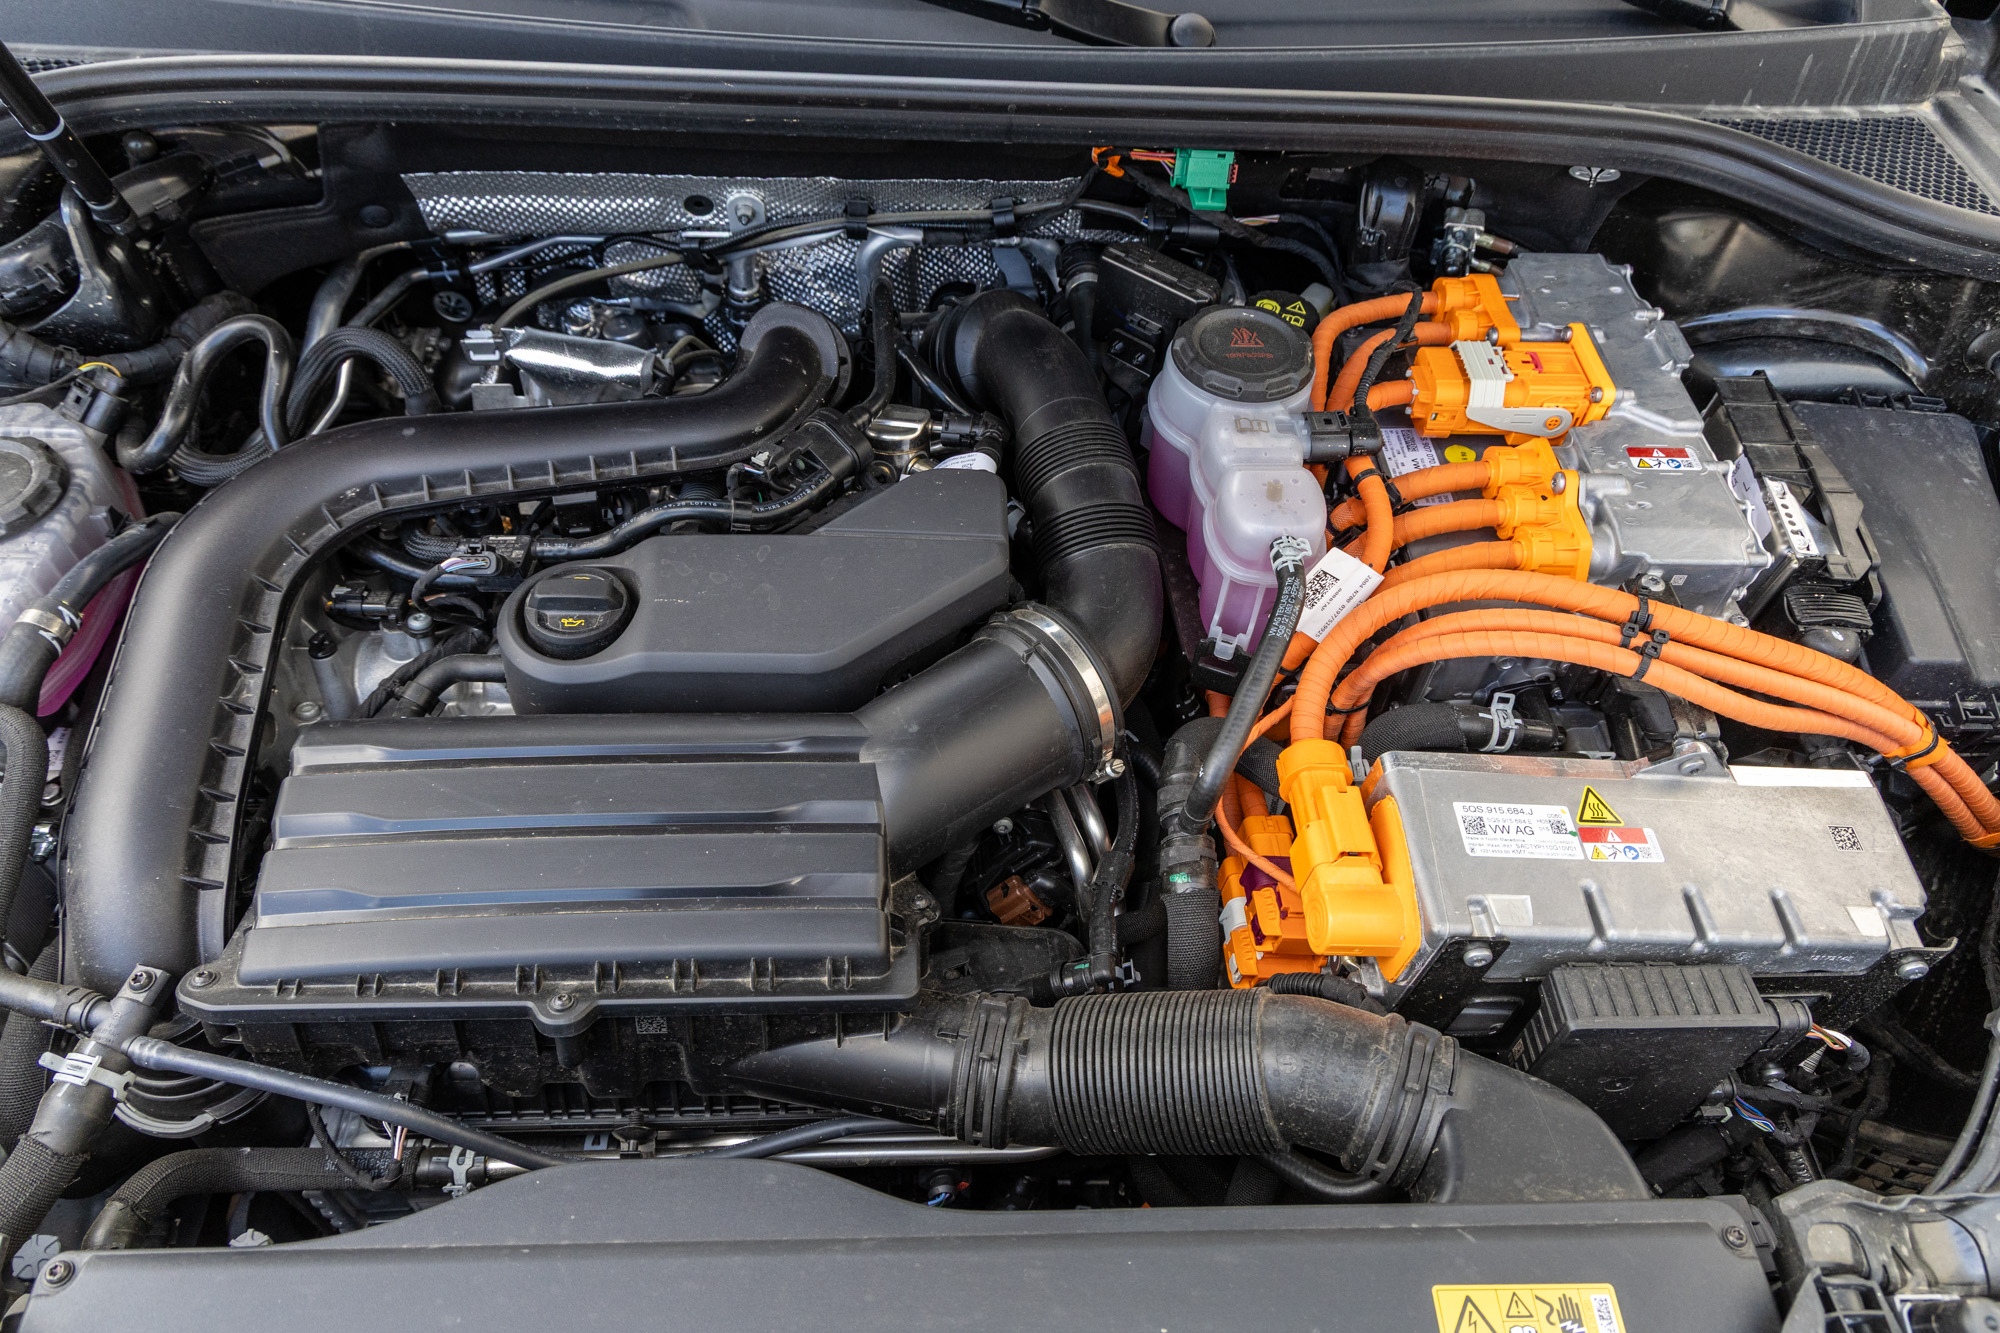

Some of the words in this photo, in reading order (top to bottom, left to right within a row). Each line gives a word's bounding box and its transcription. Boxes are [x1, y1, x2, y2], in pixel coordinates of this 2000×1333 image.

[1411, 457, 1421, 470] VW
[1268, 626, 1278, 636] VW
[1275, 594, 1289, 617] TEKLAS
[1276, 624, 1286, 638] 5QS
[1281, 614, 1289, 624] 121
[1462, 804, 1533, 816] 5QS.915.684.J
[1488, 824, 1511, 835] VW
[1515, 824, 1535, 836] AG
